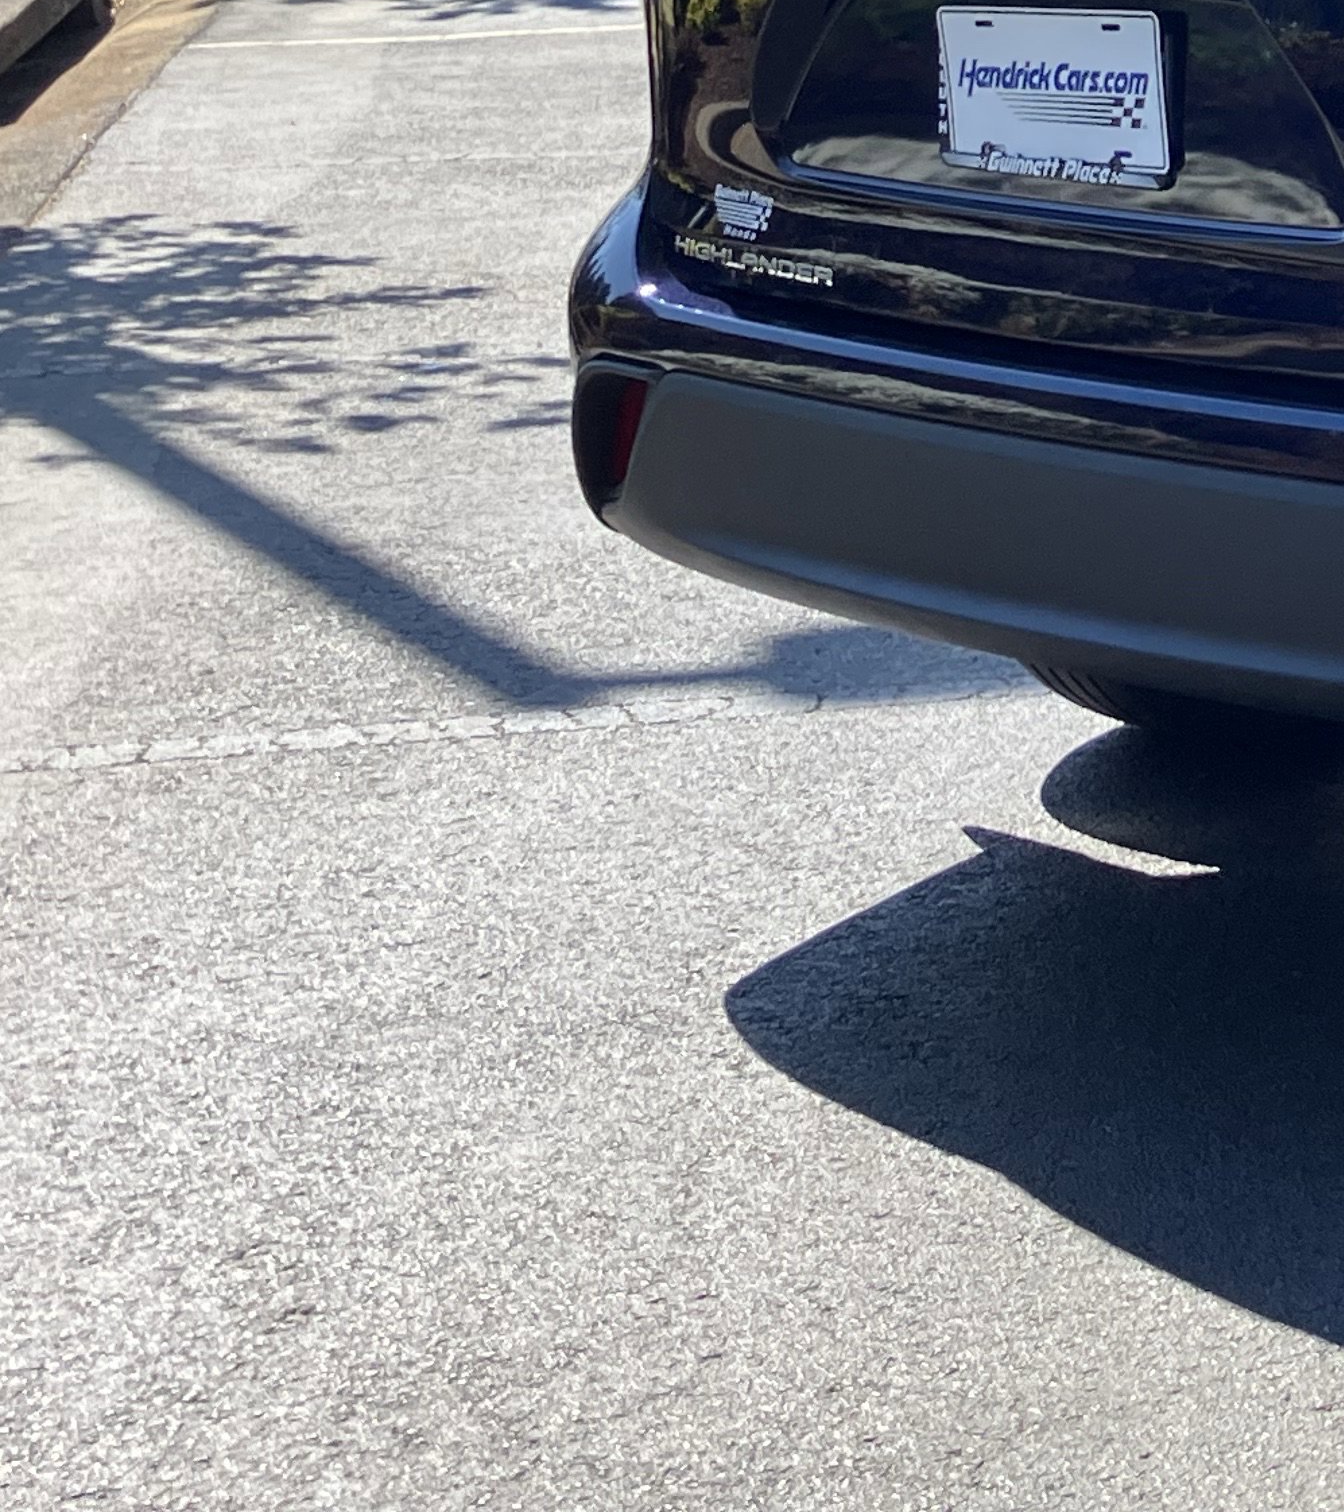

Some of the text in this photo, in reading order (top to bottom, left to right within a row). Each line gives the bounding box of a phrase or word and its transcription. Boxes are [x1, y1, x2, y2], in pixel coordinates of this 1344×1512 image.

[987, 150, 1110, 185] Gwinnett Place
[674, 234, 834, 288] HIGHLANDER
